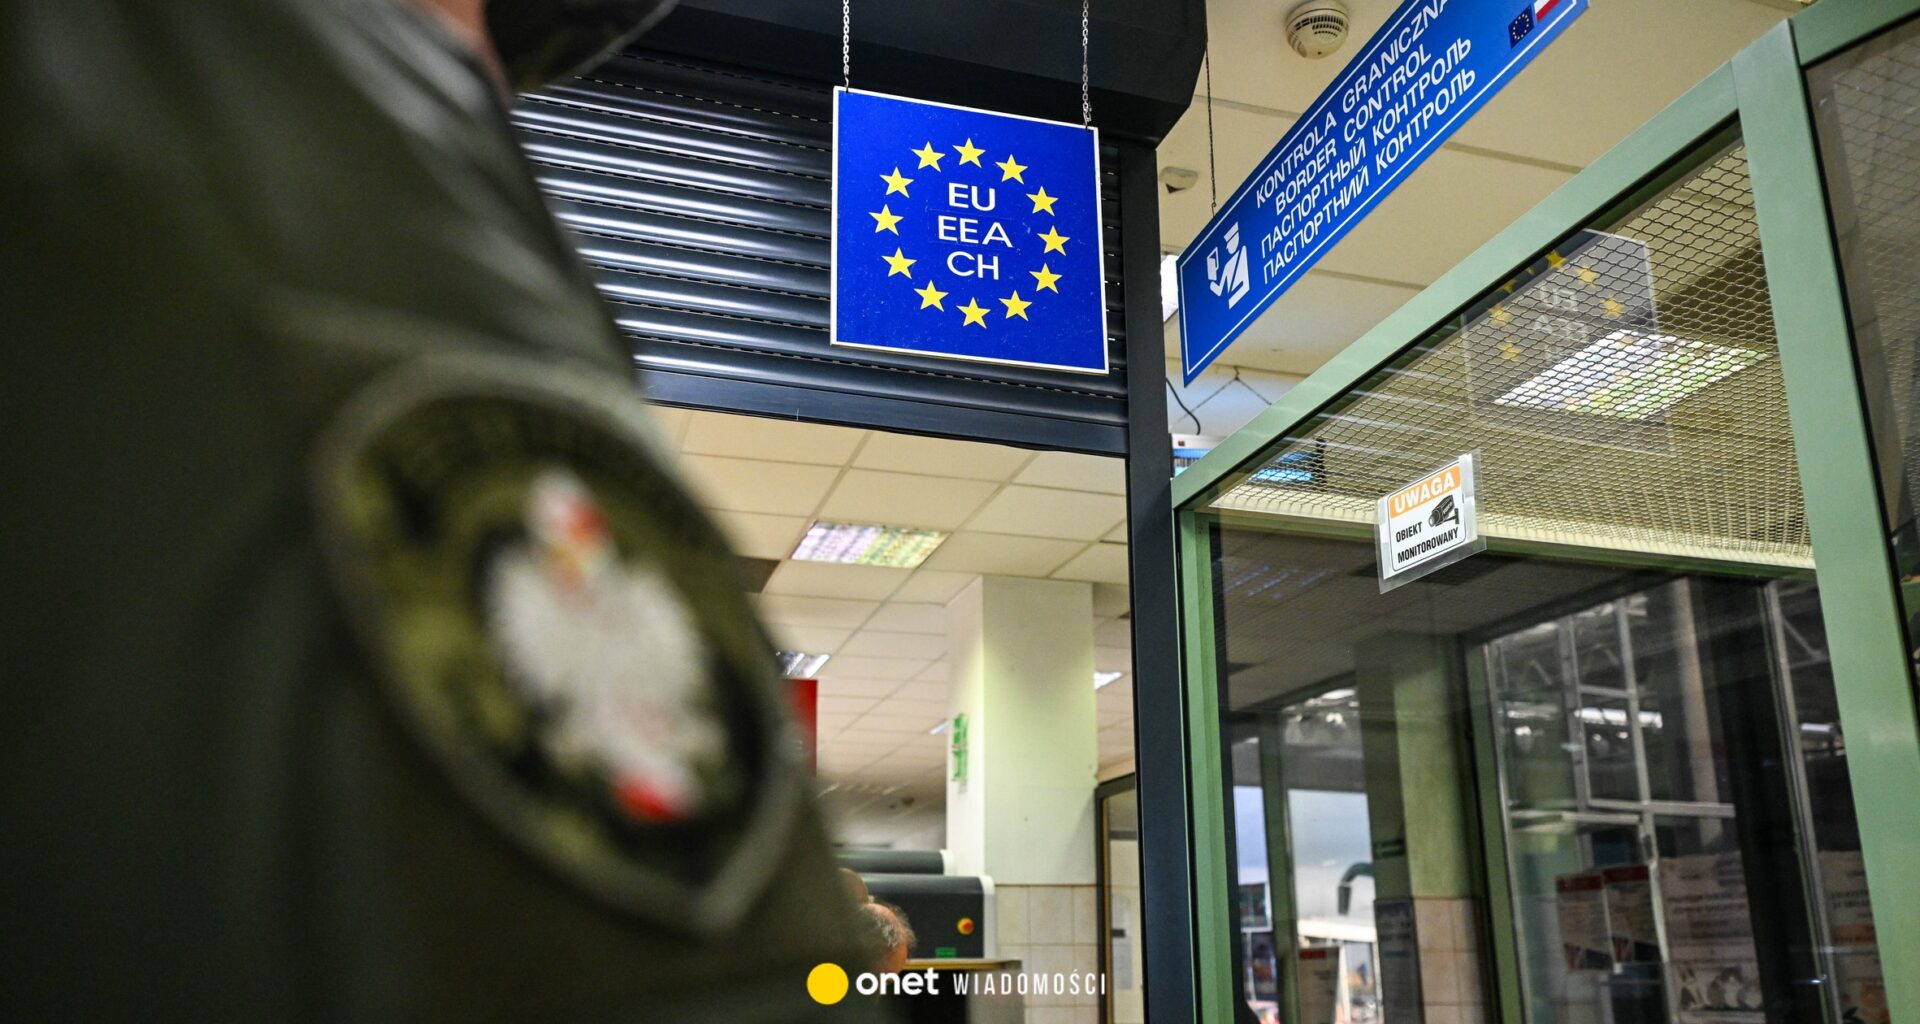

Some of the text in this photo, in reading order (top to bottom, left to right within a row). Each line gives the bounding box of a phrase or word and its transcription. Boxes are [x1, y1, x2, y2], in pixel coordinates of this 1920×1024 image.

[1261, 38, 1471, 258] ПАСПОРТНЫЙ КОНТРОЛЬ
[1275, 44, 1431, 215] BORDER CONTROL
[1256, 111, 1337, 208] KONTROLA
[1263, 68, 1476, 284] ПАСПОРТНИЙ КОНТРОЛЬ
[948, 182, 996, 212] EU
[937, 215, 1013, 248] EEA
[946, 251, 999, 280] CH
[1394, 471, 1455, 514] UWAGA
[1396, 522, 1422, 542] OBIEKT
[1397, 527, 1459, 563] MONITOROWANY
